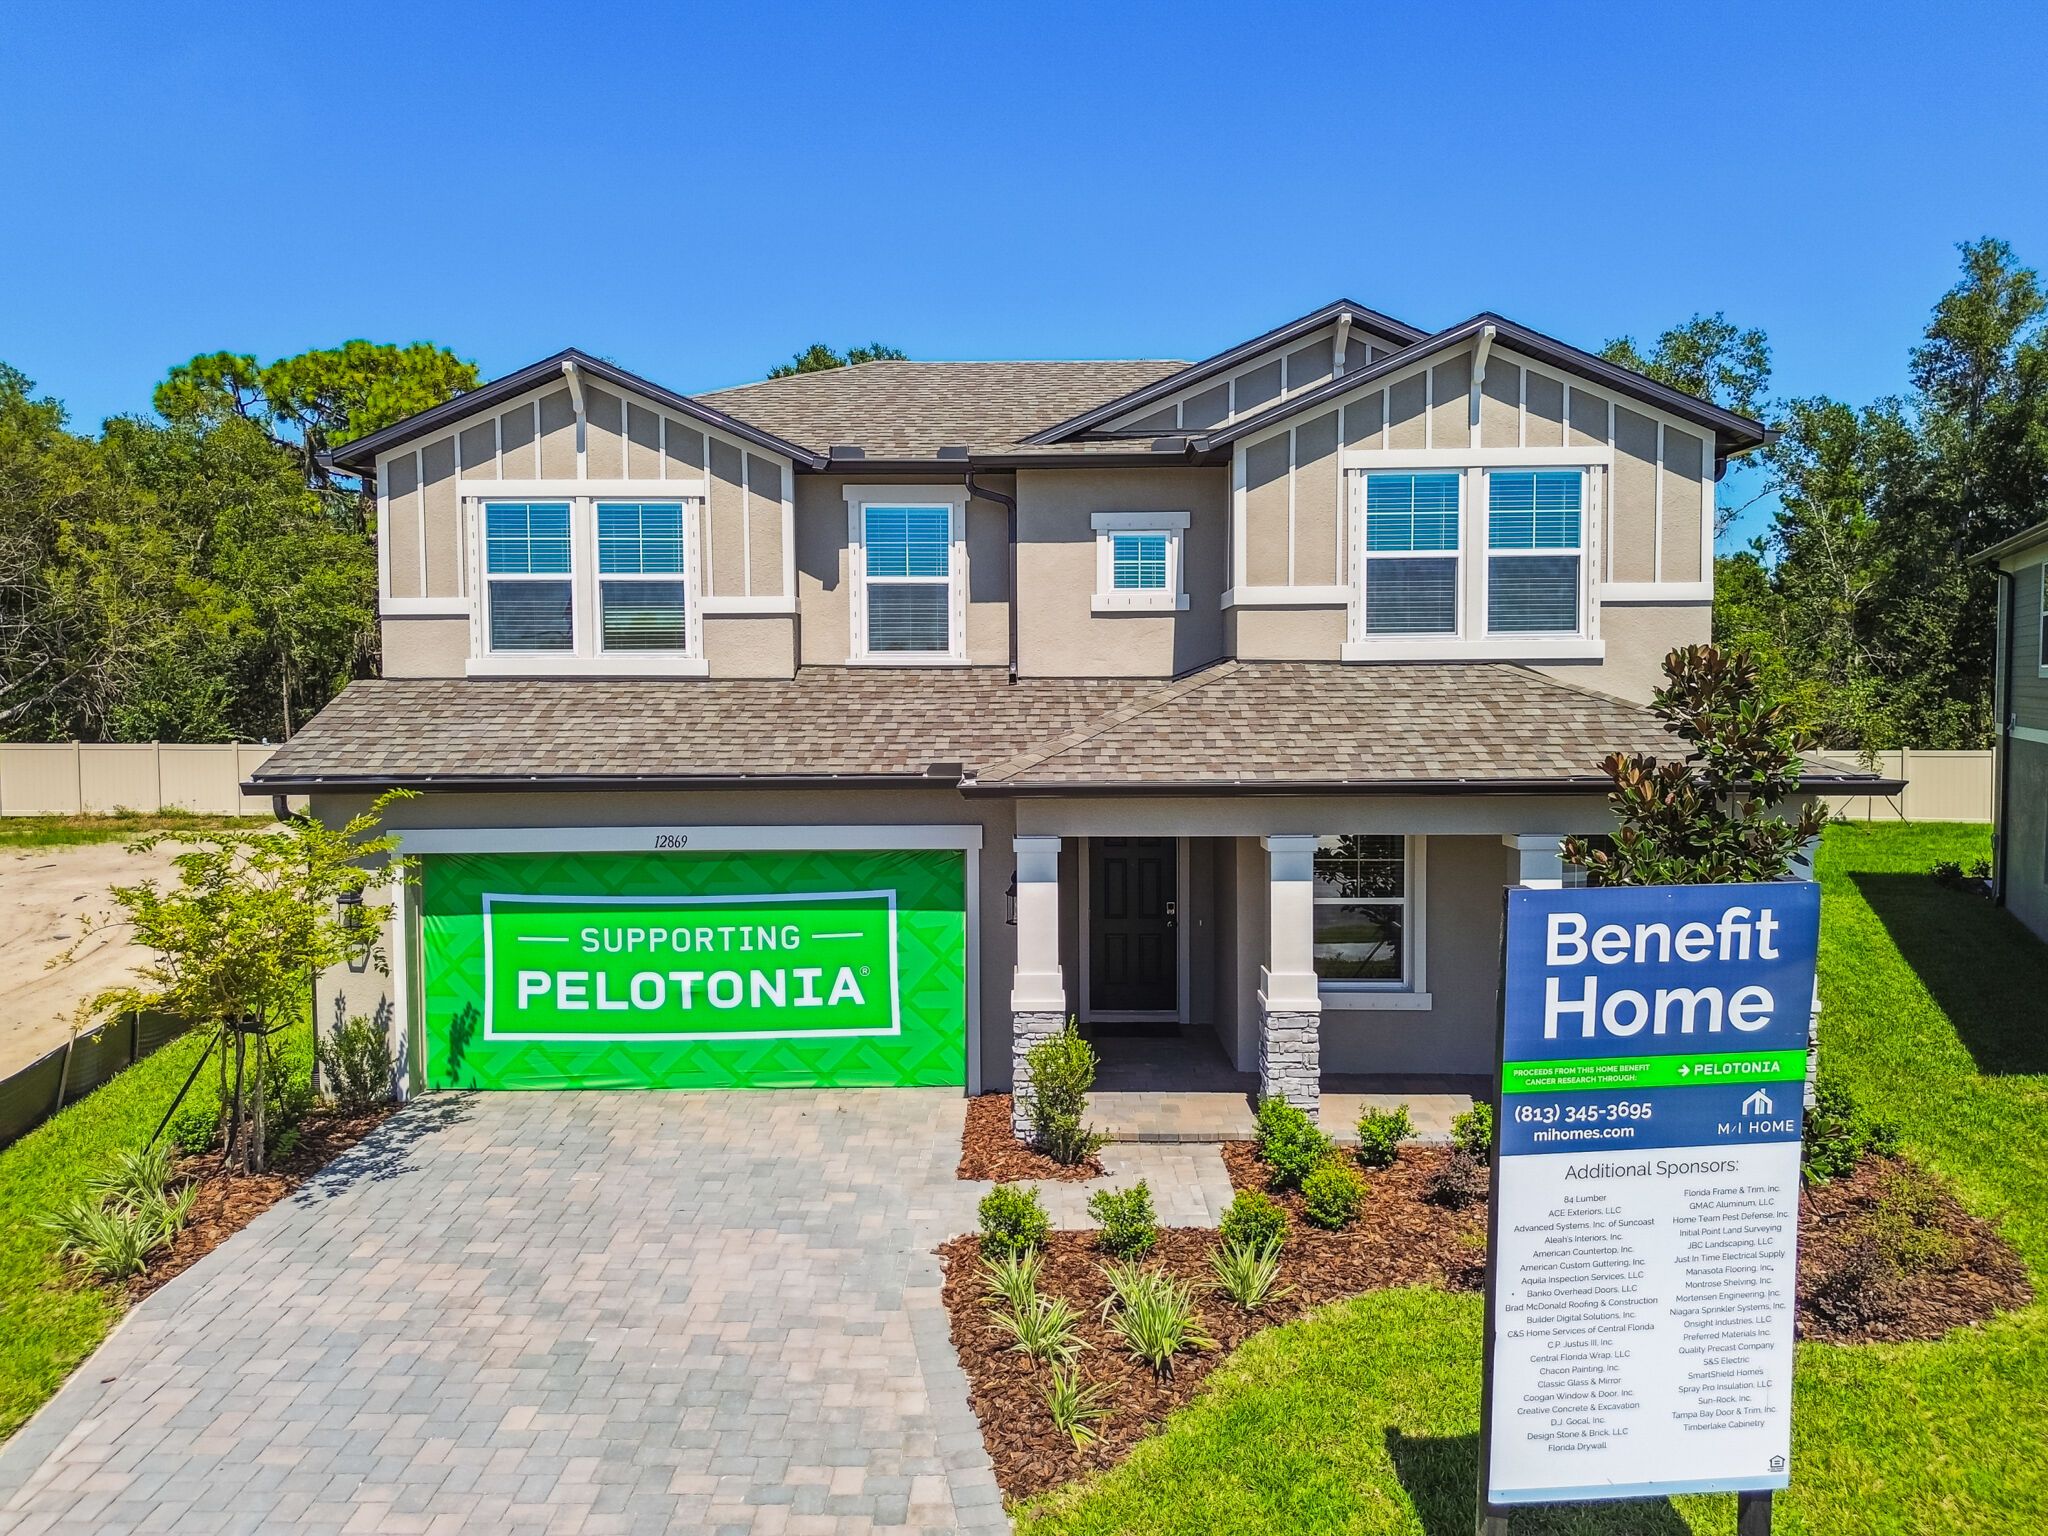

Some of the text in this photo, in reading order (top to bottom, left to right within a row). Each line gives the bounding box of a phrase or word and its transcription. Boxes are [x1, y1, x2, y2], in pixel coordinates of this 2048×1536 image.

[655, 835, 687, 848] 12869
[582, 926, 800, 951] SUPPORTING
[1546, 907, 1779, 966] Benefit
[1544, 976, 1775, 1039] Home
[1619, 1064, 1650, 1072] BENEFIT
[1694, 1061, 1780, 1076] PELOTONIA
[1525, 1075, 1637, 1086] CANCER RESEARCH THROUGH:
[1514, 1101, 1652, 1124] (813) 345-3695
[1749, 1120, 1795, 1134] HOME
[1533, 1127, 1635, 1142] mihomes.com
[1564, 1160, 1739, 1179] Additional Sponsors:
[1563, 1194, 1607, 1204] 84 Lumber
[1689, 1201, 1714, 1209] GMAC
[1758, 1198, 1774, 1206] LLC
[1548, 1209, 1565, 1217] ACE
[1605, 1206, 1621, 1214] LLC
[1698, 1214, 1720, 1222] Team
[1722, 1213, 1739, 1221] Pest
[1513, 1223, 1554, 1232] Advanced
[1608, 1219, 1617, 1227] of
[1618, 1218, 1655, 1227] Suncoast
[1680, 1228, 1700, 1236] Initial
[1722, 1226, 1742, 1234] Land
[1744, 1225, 1782, 1233] Surveying
[1687, 1241, 1703, 1249] JBC
[1757, 1237, 1773, 1245] LLC
[1532, 1250, 1572, 1258] American
[1722, 1251, 1757, 1260] Electrical
[1758, 1250, 1785, 1259] Supply
[1686, 1267, 1723, 1275] Manasota
[1521, 1277, 1546, 1285] Aquila
[1548, 1275, 1589, 1284] Inspection
[1628, 1271, 1644, 1279] LLC
[1527, 1289, 1552, 1297] Banko
[1554, 1287, 1592, 1296] Overhead
[1622, 1284, 1637, 1292] LLC
[1676, 1294, 1717, 1302] Mortensen
[1505, 1304, 1524, 1312] Brad
[1526, 1301, 1567, 1310] McDonald
[1568, 1300, 1599, 1308] Roofing
[1608, 1297, 1658, 1306] Construction
[1670, 1308, 1699, 1316] Niagara
[1701, 1305, 1735, 1314] Sprinkler
[1526, 1316, 1555, 1324] Builder
[1556, 1314, 1582, 1323] Digital
[1684, 1319, 1714, 1328] Onsight
[1756, 1315, 1772, 1323] LLC
[1507, 1329, 1524, 1338] C&S
[1597, 1324, 1626, 1332] Central
[1627, 1323, 1654, 1331] Florida
[1683, 1332, 1720, 1340] Preferred
[1721, 1330, 1757, 1338] Materials
[1563, 1340, 1589, 1348] Justus
[1678, 1342, 1774, 1354] Quality Precast Company
[1530, 1354, 1559, 1362] Central
[1614, 1350, 1630, 1358] LLC
[1703, 1356, 1749, 1365] S&S Electric
[1688, 1369, 1734, 1379] SmartShield
[1537, 1380, 1565, 1388] Classic
[1678, 1386, 1700, 1394] Spray
[1756, 1380, 1772, 1388] LLC
[1523, 1394, 1555, 1402] Coogan
[1517, 1406, 1550, 1415] Creative
[1551, 1405, 1588, 1413] Concrete
[1598, 1402, 1640, 1410] Excavation
[1672, 1411, 1698, 1419] Tampa
[1700, 1410, 1714, 1418] Bay
[1715, 1408, 1734, 1416] Door
[1683, 1420, 1765, 1430] Timberlake Cabinetry
[1526, 1432, 1555, 1441] Design
[1612, 1427, 1629, 1435] LLC
[1577, 1442, 1607, 1451] Drywall
